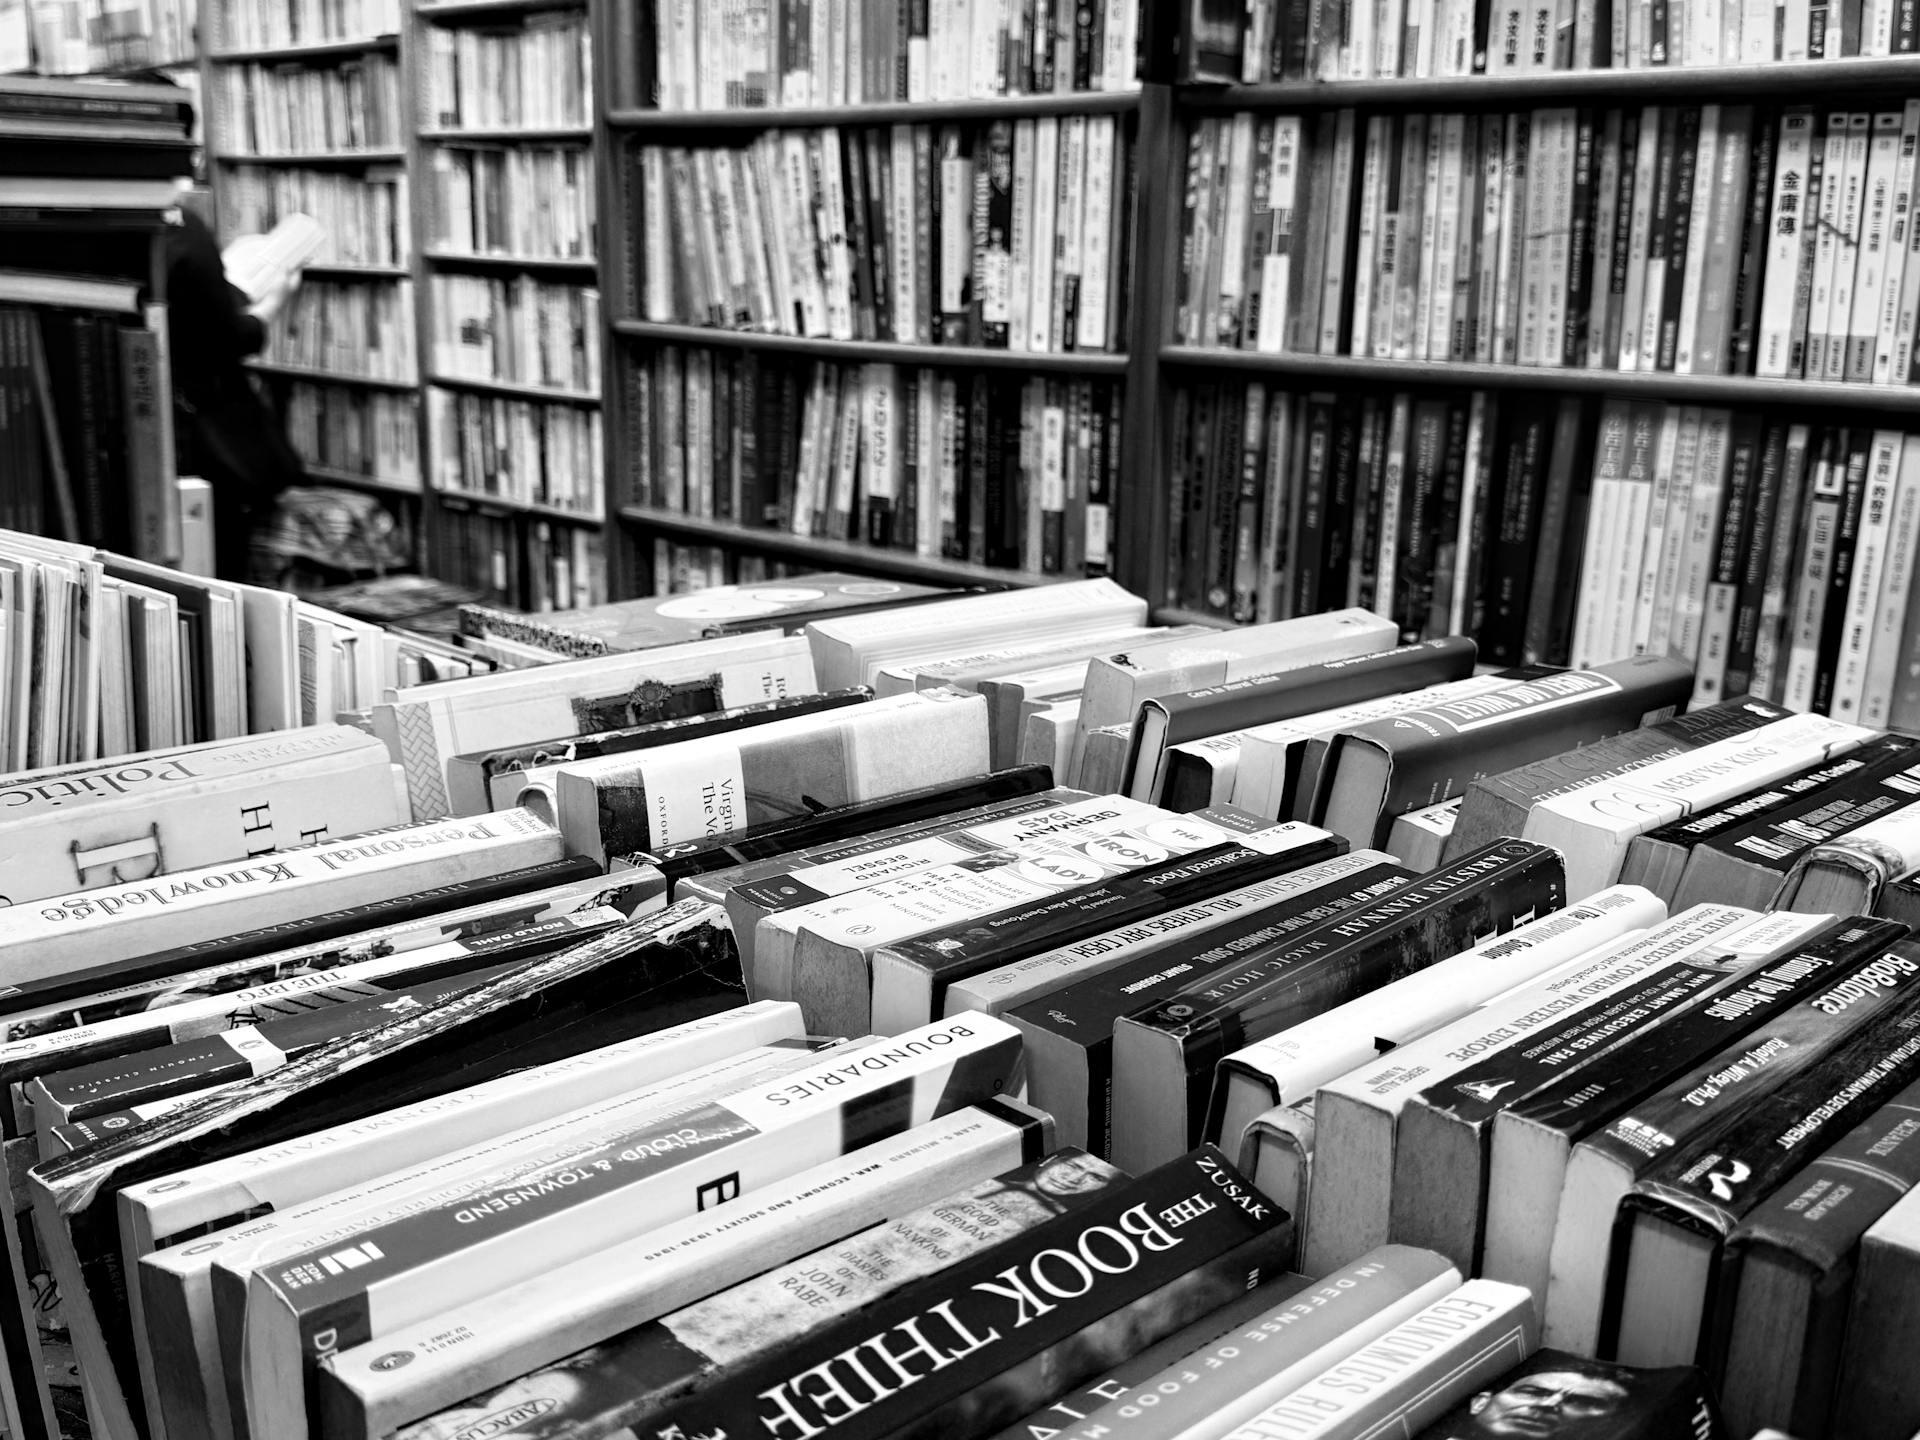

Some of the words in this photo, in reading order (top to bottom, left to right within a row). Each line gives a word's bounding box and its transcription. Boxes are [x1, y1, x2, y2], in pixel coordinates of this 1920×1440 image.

[1653, 756, 1728, 794] MERVYN
[1722, 744, 1778, 774] KING
[702, 782, 717, 814] The
[658, 796, 670, 847] OXFORD
[1014, 809, 1123, 843] GERMANY
[1017, 810, 1078, 828] 1945
[312, 821, 501, 871] Personal
[1172, 828, 1204, 842] THE
[822, 833, 900, 866] COURTESAN
[841, 853, 909, 874] BESSEL
[1098, 838, 1154, 866] IRON
[1188, 848, 1258, 874] Scattered
[853, 857, 933, 881] RICHARD
[1030, 857, 1096, 881] LADY
[1143, 867, 1195, 888] Flock
[1302, 855, 1374, 885] VENGEANCE
[1423, 853, 1511, 894] KRISTIN
[40, 861, 304, 922] Knowledge
[364, 883, 469, 911] HISTORY
[1350, 889, 1373, 902] 67
[1362, 876, 1410, 898] DETROIT
[325, 909, 356, 922] IN
[1207, 894, 1240, 916] ALL
[1311, 904, 1342, 921] YEAR
[1331, 892, 1430, 937] HANNAH
[1332, 897, 1360, 911] THE
[1567, 905, 1600, 920] The
[514, 920, 566, 940] ROALD
[1146, 901, 1211, 938] OTHERS
[1277, 912, 1316, 932] THAT
[1698, 911, 1745, 934] SOVIET
[182, 918, 315, 952] PRACTICE
[470, 932, 512, 948] DAHL
[1070, 938, 1123, 958] CASH
[1116, 922, 1151, 946] PAY
[1228, 922, 1286, 952] CHANGED
[1640, 926, 1706, 966] STRATEGY
[1264, 941, 1328, 969] MAGIC
[1476, 938, 1534, 960] Solution
[296, 970, 348, 992] THE
[1576, 962, 1645, 995] TOWARD
[1688, 972, 1716, 988] WHY
[1768, 940, 1831, 996] Framing
[236, 982, 290, 1004] BFG
[1203, 969, 1265, 999] HOUR
[1628, 991, 1645, 1002] CAN
[1811, 952, 1919, 1015] BioBalance
[1509, 989, 1584, 1031] WESTERN
[1606, 998, 1631, 1013] LEARN
[1649, 986, 1689, 1011] SMART
[1703, 980, 1763, 1034] Margins
[1561, 1023, 1588, 1039] THEIR
[1577, 1008, 1650, 1051] EXECUTIVES
[1582, 1008, 1609, 1026] FROM
[1444, 1025, 1520, 1062] EUROPE
[1521, 1035, 1563, 1059] MISTAKES
[1538, 1048, 1577, 1066] FAIL
[1746, 1031, 1789, 1068] Rudolf
[150, 1052, 214, 1072] PENGUIN
[765, 1024, 977, 1108] BOUNDARIES
[1708, 1060, 1746, 1094] Wiley,
[1837, 1062, 1887, 1104] TAIWAN'S
[1680, 1079, 1717, 1113] Ph.D.
[352, 1092, 488, 1136] YEONMI
[1773, 1091, 1848, 1151] DEVELOPMENT
[954, 1121, 981, 1137] ALAN
[240, 1135, 338, 1168] PARK
[620, 1128, 699, 1163] CLOUD
[888, 1137, 939, 1164] MILWARD
[592, 1157, 614, 1172] &
[849, 1160, 880, 1179] WAR,
[455, 1166, 594, 1225] TOWNSEND
[794, 1172, 850, 1202] ECONOMY
[1196, 1156, 1271, 1221] ZUSAK
[767, 1197, 791, 1212] AND
[959, 1203, 1000, 1228] GOOD
[984, 1201, 1008, 1218] THE
[1159, 1193, 1218, 1229] THE
[714, 1207, 765, 1234] SOCIETY
[929, 1225, 949, 1239] OF
[932, 1207, 992, 1241] GERMAN
[893, 1223, 950, 1261] NANKING
[838, 1251, 888, 1283] DIARIES
[867, 1249, 895, 1267] THE
[971, 1201, 1185, 1329] BOOK
[1356, 1261, 1385, 1280] IN
[798, 1267, 852, 1299] JOHN
[835, 1266, 856, 1280] OF
[778, 1276, 830, 1309] RABE
[1255, 1278, 1357, 1343] DEFENSE
[1205, 1346, 1240, 1369] OF
[1322, 1297, 1497, 1398] ECONOMICS
[757, 1299, 1002, 1440] THIEF
[1119, 1370, 1199, 1419] FOOD
